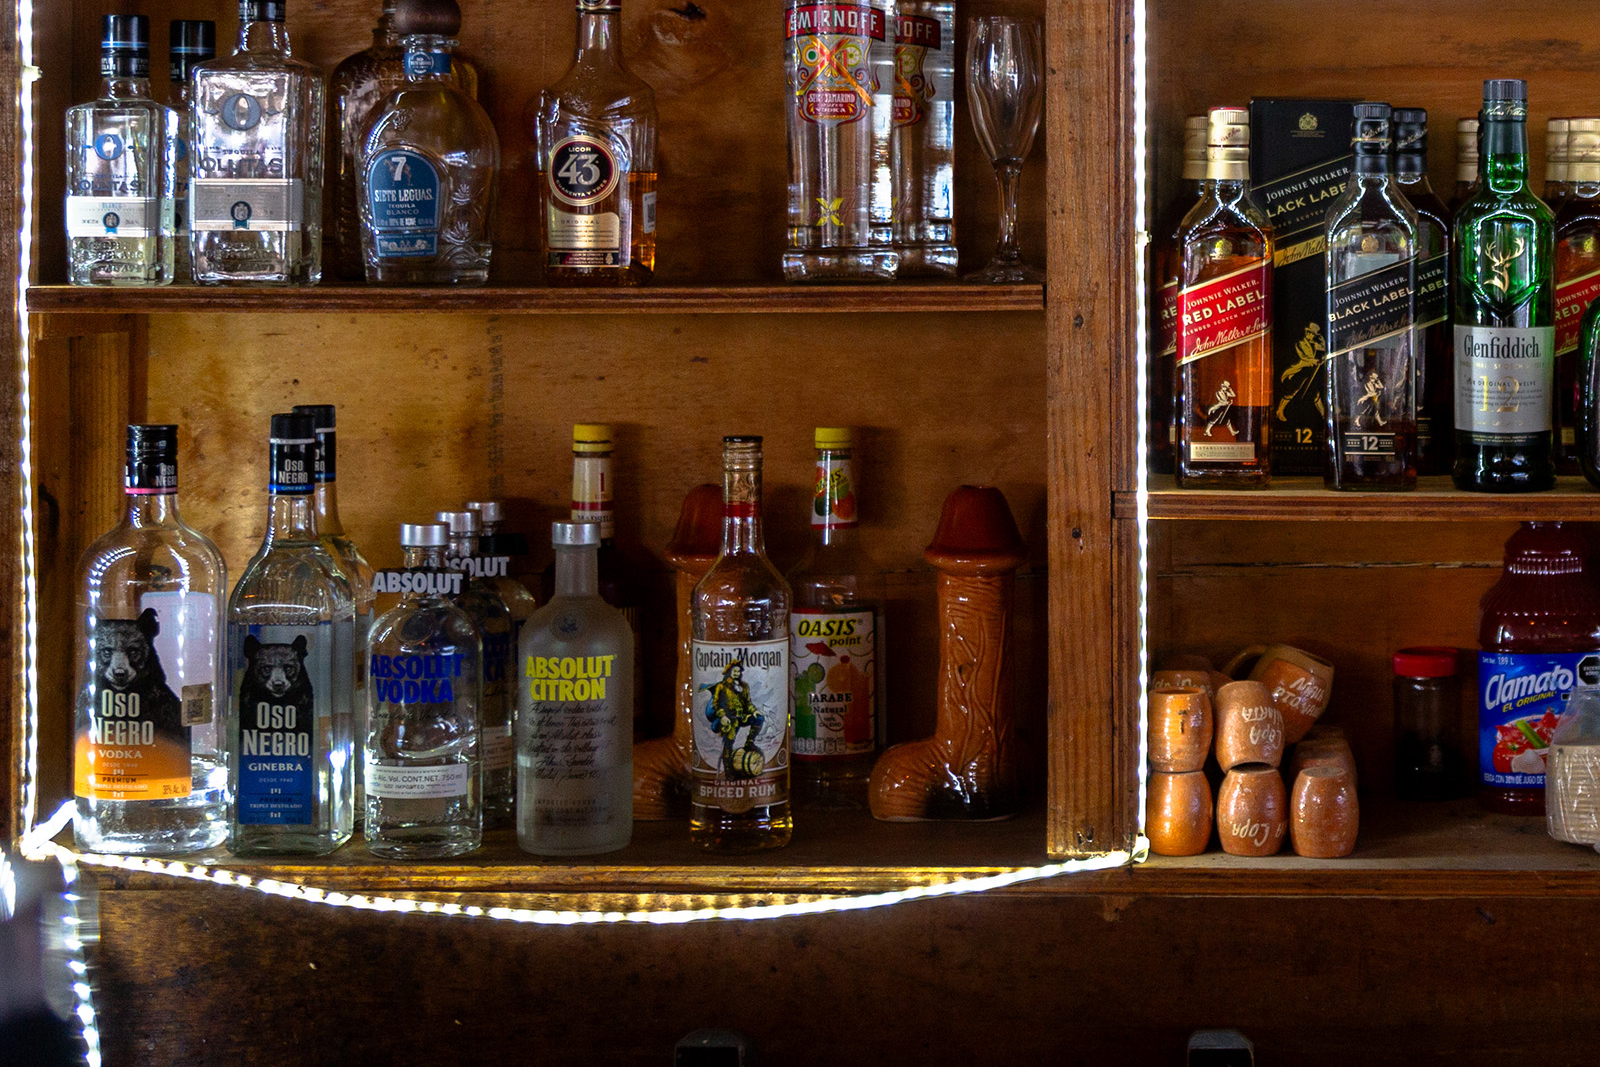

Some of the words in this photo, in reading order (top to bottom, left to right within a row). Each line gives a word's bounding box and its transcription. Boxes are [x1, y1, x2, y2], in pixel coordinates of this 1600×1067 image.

[790, 9, 879, 33] SMIRNOFF
[391, 156, 407, 182] 7
[557, 154, 601, 186] 43
[374, 188, 397, 203] SIETE
[398, 188, 434, 203] LEGUAS
[1266, 182, 1302, 203] JOHNNIE
[386, 209, 420, 217] BLANCO
[1186, 289, 1222, 311] JOHNNIE
[1335, 285, 1371, 308] JOHNNIE
[1182, 304, 1214, 327] RED
[1211, 314, 1239, 329] SCOTCH
[1239, 304, 1266, 319] WHISKY
[1328, 300, 1371, 323] BLACK
[1554, 302, 1582, 321] RED
[1464, 334, 1541, 359] Glenfiddich
[1479, 375, 1520, 413] 12
[1294, 428, 1313, 444] 12
[1360, 436, 1379, 452] 12
[277, 471, 308, 484] NEGRO
[284, 459, 303, 473] OSO
[371, 571, 464, 595] ABSOLUT
[797, 618, 858, 639] OASIS
[829, 636, 862, 649] point
[370, 653, 465, 680] ABSOLUT
[525, 654, 617, 679] ABSOLUT
[695, 647, 734, 674] Captain
[733, 645, 785, 672] Morgan
[375, 680, 455, 704] VODKA
[529, 678, 607, 703] CITRON
[808, 692, 853, 704] JARABE
[1485, 664, 1575, 712] Clamato
[102, 689, 142, 718] OSO
[814, 705, 848, 714] Natural
[1502, 701, 1513, 713] EL
[1515, 690, 1560, 707] ORIGINAL
[256, 701, 297, 729] OSO
[92, 720, 157, 746] NEGRO
[243, 730, 312, 757] NEGRO
[99, 750, 143, 759] VODKA
[248, 762, 304, 772] GINEBRA
[699, 785, 747, 800] SPICED
[749, 785, 777, 798] RUM
